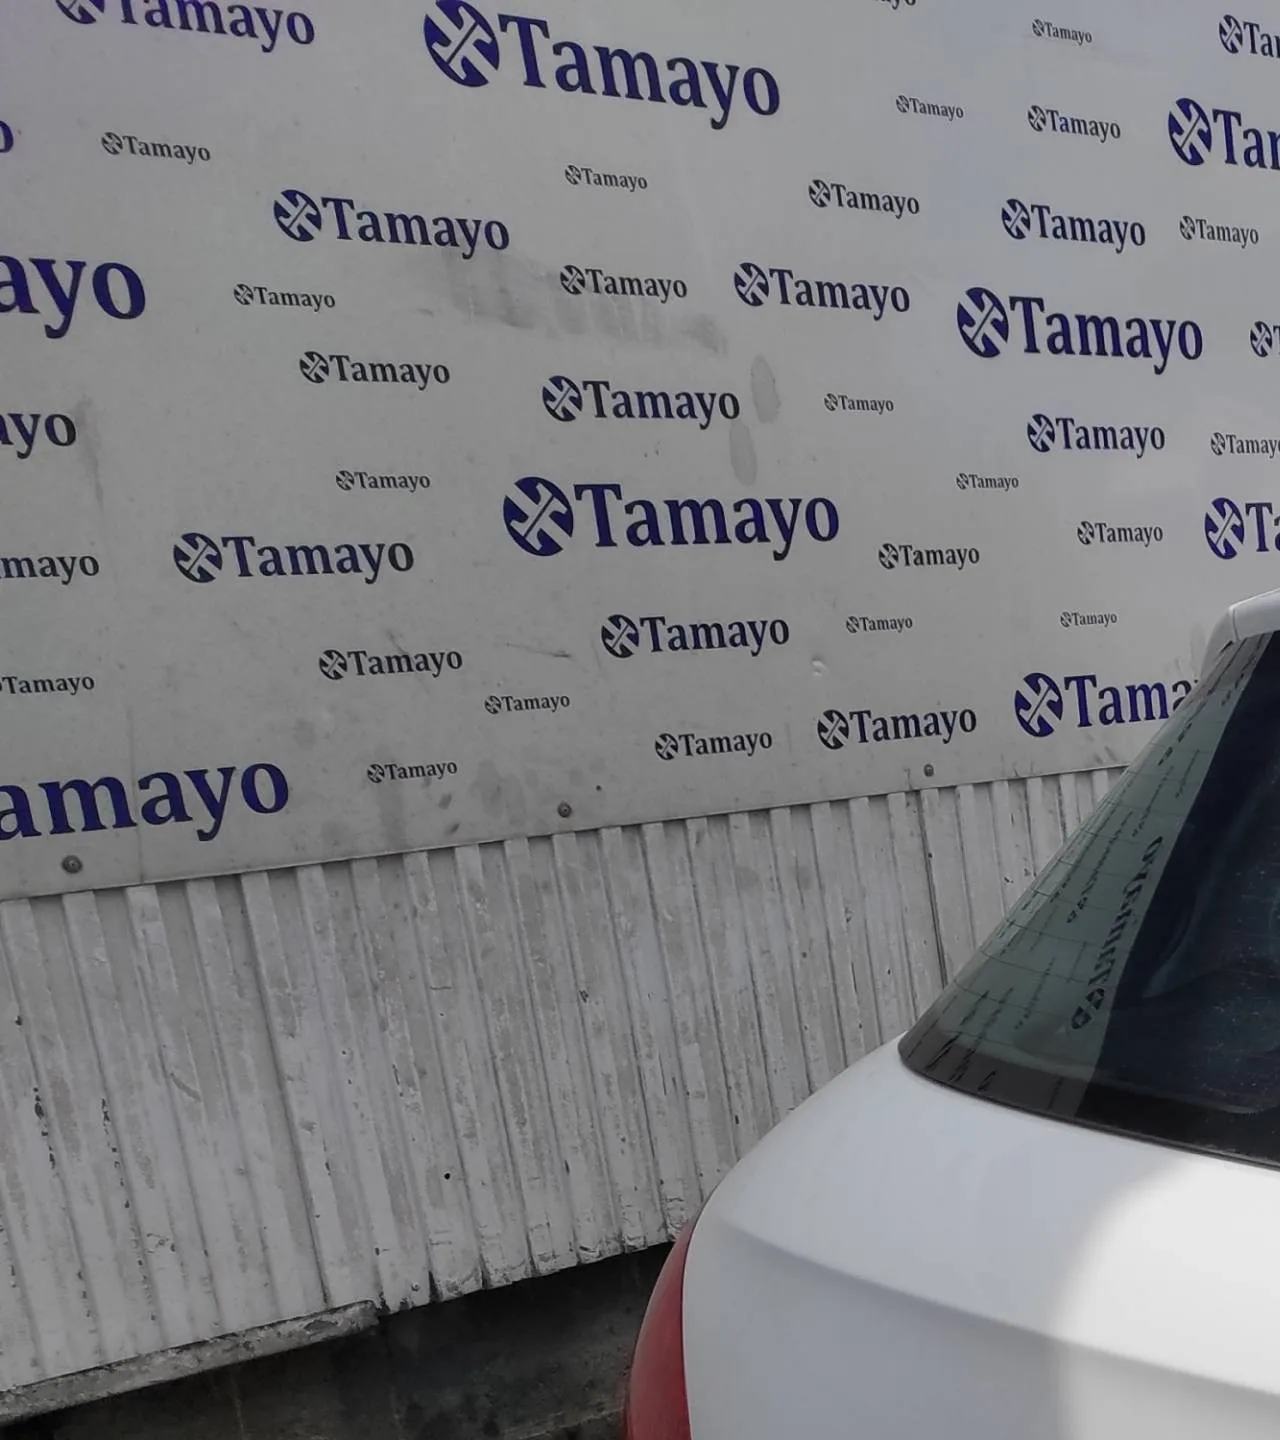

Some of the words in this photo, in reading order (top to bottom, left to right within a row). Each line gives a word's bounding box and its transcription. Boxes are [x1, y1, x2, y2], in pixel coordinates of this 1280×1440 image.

[1044, 21, 1093, 47] Tamayo
[499, 13, 780, 131] Tamayo
[907, 97, 964, 122] Tamayo
[1044, 108, 1121, 144] Tamayo
[121, 135, 211, 166] Tamayo
[580, 167, 648, 193] Tamayo
[831, 183, 920, 220] Tamayo
[320, 196, 510, 261] Tamayo
[1029, 203, 1146, 255] Tamayo
[1194, 218, 1259, 249] Tamayo
[0, 255, 146, 340] ayo
[255, 286, 336, 313] Tamayo
[584, 268, 688, 304] Tamayo
[768, 267, 910, 322] Tamayo
[1008, 295, 1203, 376] Tamayo
[328, 354, 451, 391] Tamayo
[581, 380, 740, 431] Tamayo
[836, 394, 895, 416] Tamayo
[1053, 417, 1166, 460] Tamayo
[353, 471, 431, 494] Tamayo
[967, 473, 1019, 492] Tamayo
[573, 483, 840, 562] Tamayo
[1095, 522, 1164, 548] Tamayo
[0, 555, 100, 586] mayo
[220, 535, 415, 585] Tamayo
[899, 544, 980, 571] Tamayo
[858, 616, 913, 634] Tamayo
[1069, 612, 1118, 628] Tamayo
[640, 615, 790, 657] Tamayo
[346, 650, 463, 679] Tamayo
[1, 675, 95, 696] Tamayo
[500, 695, 570, 713] Tamayo
[848, 708, 977, 745] Tamayo
[677, 732, 773, 757] Tamayo
[383, 761, 458, 781] Tamayo
[0, 762, 290, 842] amayo
